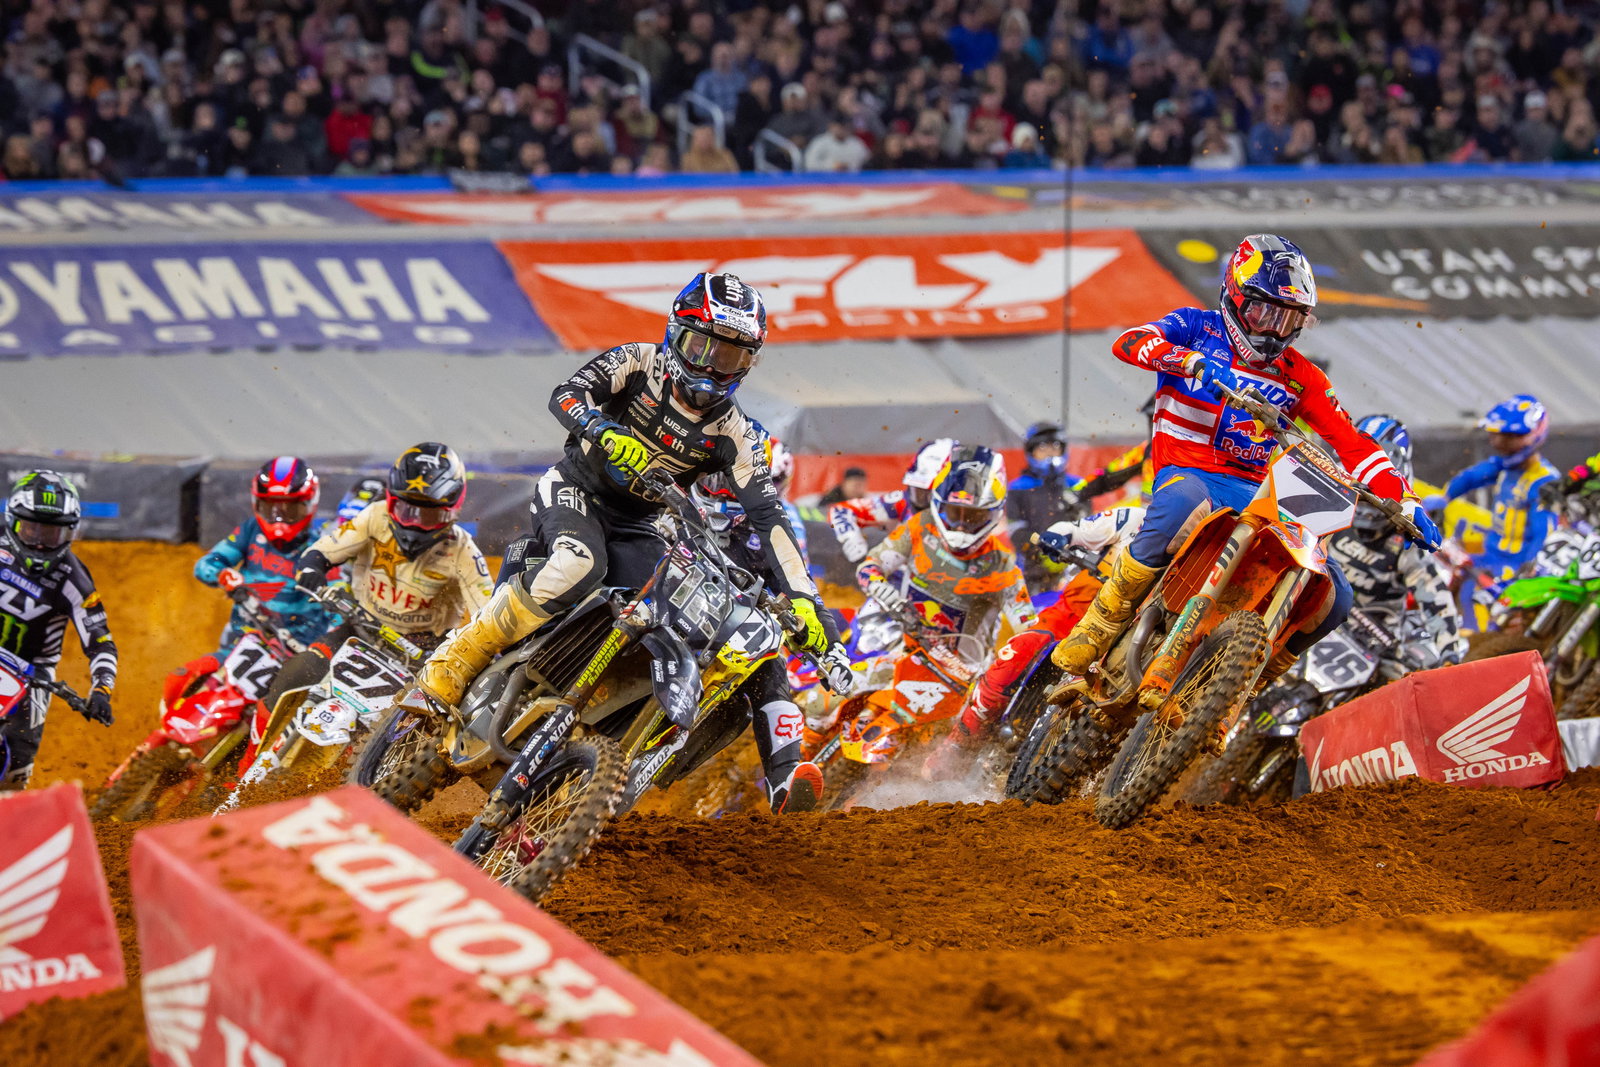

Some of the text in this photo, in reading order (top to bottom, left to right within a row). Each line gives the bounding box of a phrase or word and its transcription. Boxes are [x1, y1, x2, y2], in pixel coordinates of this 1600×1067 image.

[1360, 248, 1516, 275] UTAH
[10, 257, 491, 324] YAMAHA
[556, 391, 587, 420] froth
[654, 425, 685, 453] froth
[1221, 437, 1254, 461] Red
[1277, 465, 1352, 518] 7
[369, 575, 435, 611] SEVEN
[1172, 608, 1201, 659] DUNOP
[232, 648, 283, 699] 14
[333, 654, 406, 699] 27
[575, 627, 621, 688] connection
[1312, 641, 1369, 685] 46
[894, 679, 951, 714] 4
[1441, 751, 1550, 783] HONDA
[0, 953, 103, 993] NDA
